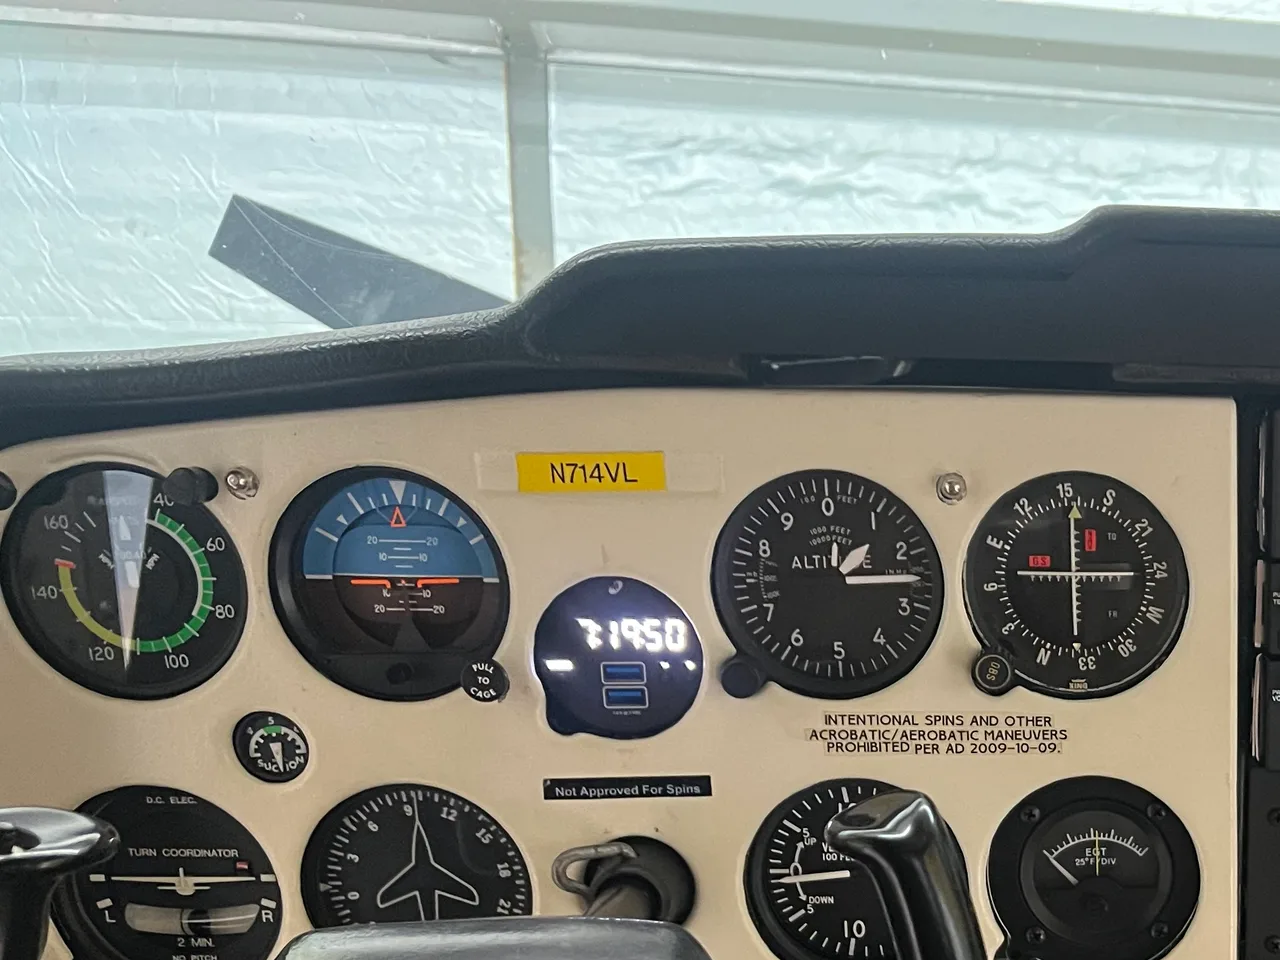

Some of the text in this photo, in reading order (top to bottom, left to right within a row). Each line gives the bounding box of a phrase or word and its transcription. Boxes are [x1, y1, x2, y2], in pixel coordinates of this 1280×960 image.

[550, 462, 639, 484] N714VL
[1056, 483, 1073, 498] 15
[1103, 489, 1116, 506] S
[822, 497, 834, 516] 0
[1013, 497, 1034, 517] 12
[44, 515, 69, 529] 160
[870, 511, 876, 530] 1
[1135, 518, 1153, 537] 21
[809, 525, 851, 536] 1000 FEET
[206, 538, 225, 552] 60
[1153, 561, 1168, 579] 24
[31, 586, 58, 599] 140
[215, 604, 235, 618] 80
[89, 647, 114, 661] 120
[1118, 638, 1137, 658] 30
[165, 654, 189, 668] 100
[1078, 656, 1097, 671] 33
[472, 663, 494, 674] PULL
[986, 661, 1001, 681] OBS
[477, 677, 490, 685] TO
[470, 687, 497, 699] CAGE
[824, 714, 1053, 727] INTENTIONAL SPINS AND OTHER
[809, 729, 1068, 741] ACROBATIC/AEROBATIC MANEUVERS
[826, 741, 1060, 755] PROHIBITED PER AD 2009-10-09.
[555, 784, 701, 798] Not Approved For Spins
[440, 806, 458, 821] 12
[475, 827, 494, 844] 15
[128, 848, 239, 858] TURN COORDINATOR
[822, 853, 838, 861] 100
[1086, 847, 1106, 857] EGT
[496, 862, 511, 878] 18
[496, 898, 511, 915] 21
[808, 896, 835, 904] DOWN
[105, 910, 116, 923] L
[261, 910, 274, 923] R
[844, 920, 866, 938] 10
